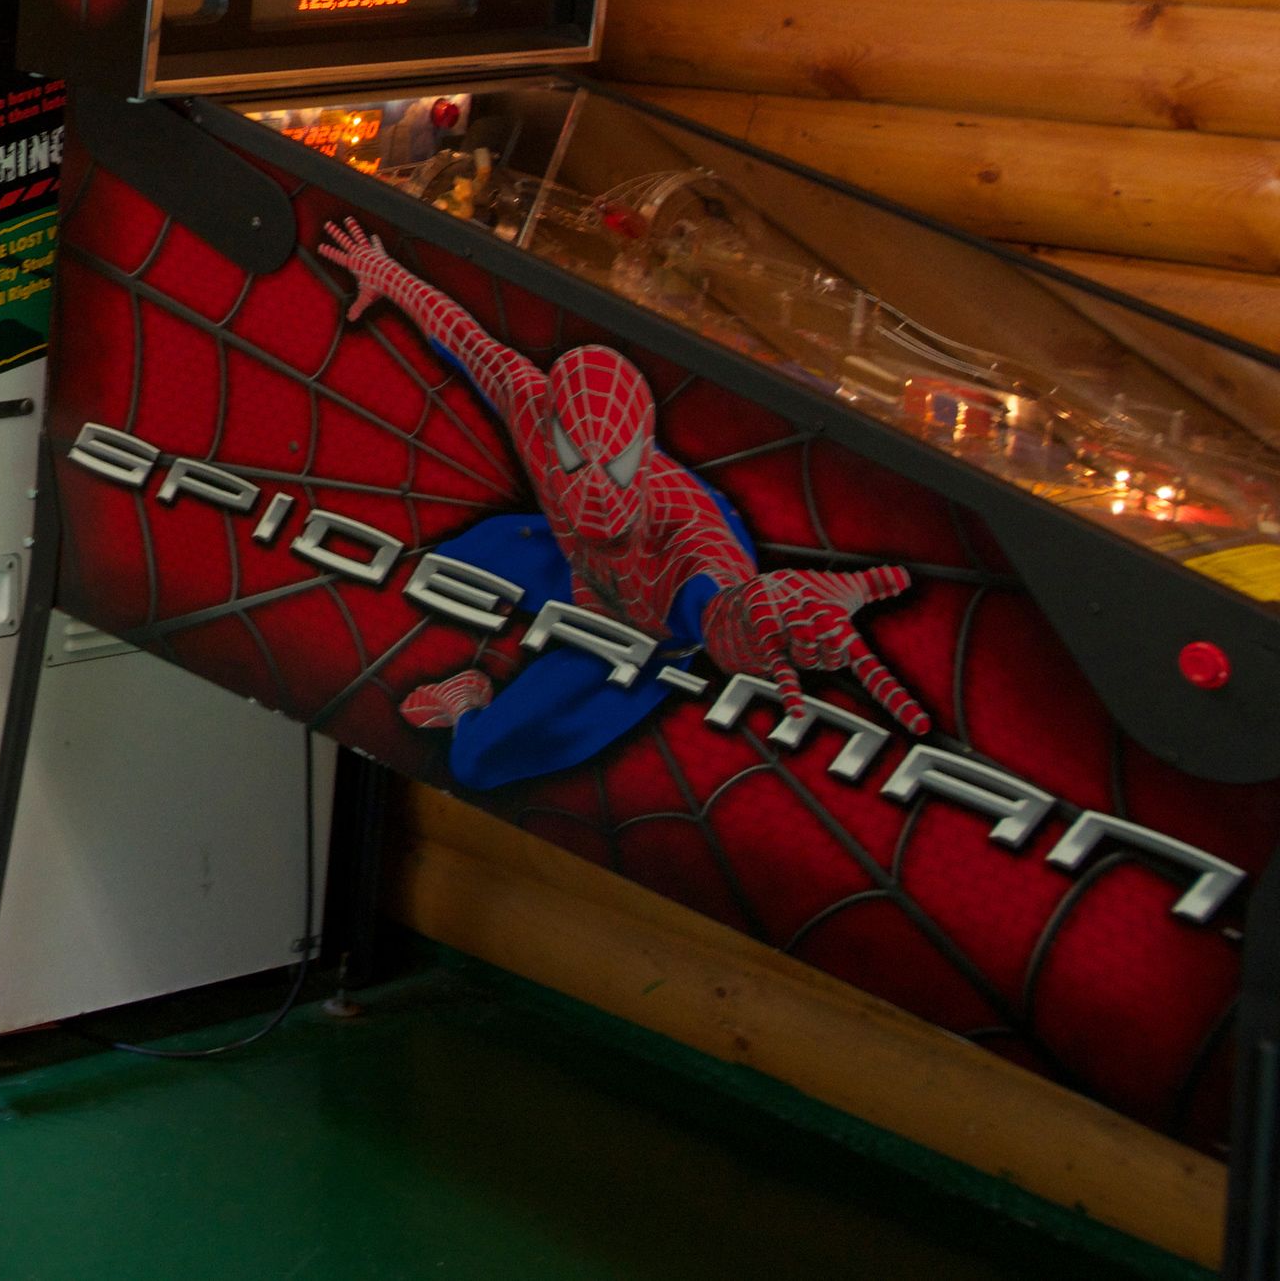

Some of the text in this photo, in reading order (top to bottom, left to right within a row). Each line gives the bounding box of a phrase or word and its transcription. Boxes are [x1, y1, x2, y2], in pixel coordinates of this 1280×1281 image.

[9, 230, 44, 254] LOST
[22, 250, 57, 274] Stud
[7, 277, 52, 300] Rights
[68, 421, 1248, 924] SPIDER-MAN
